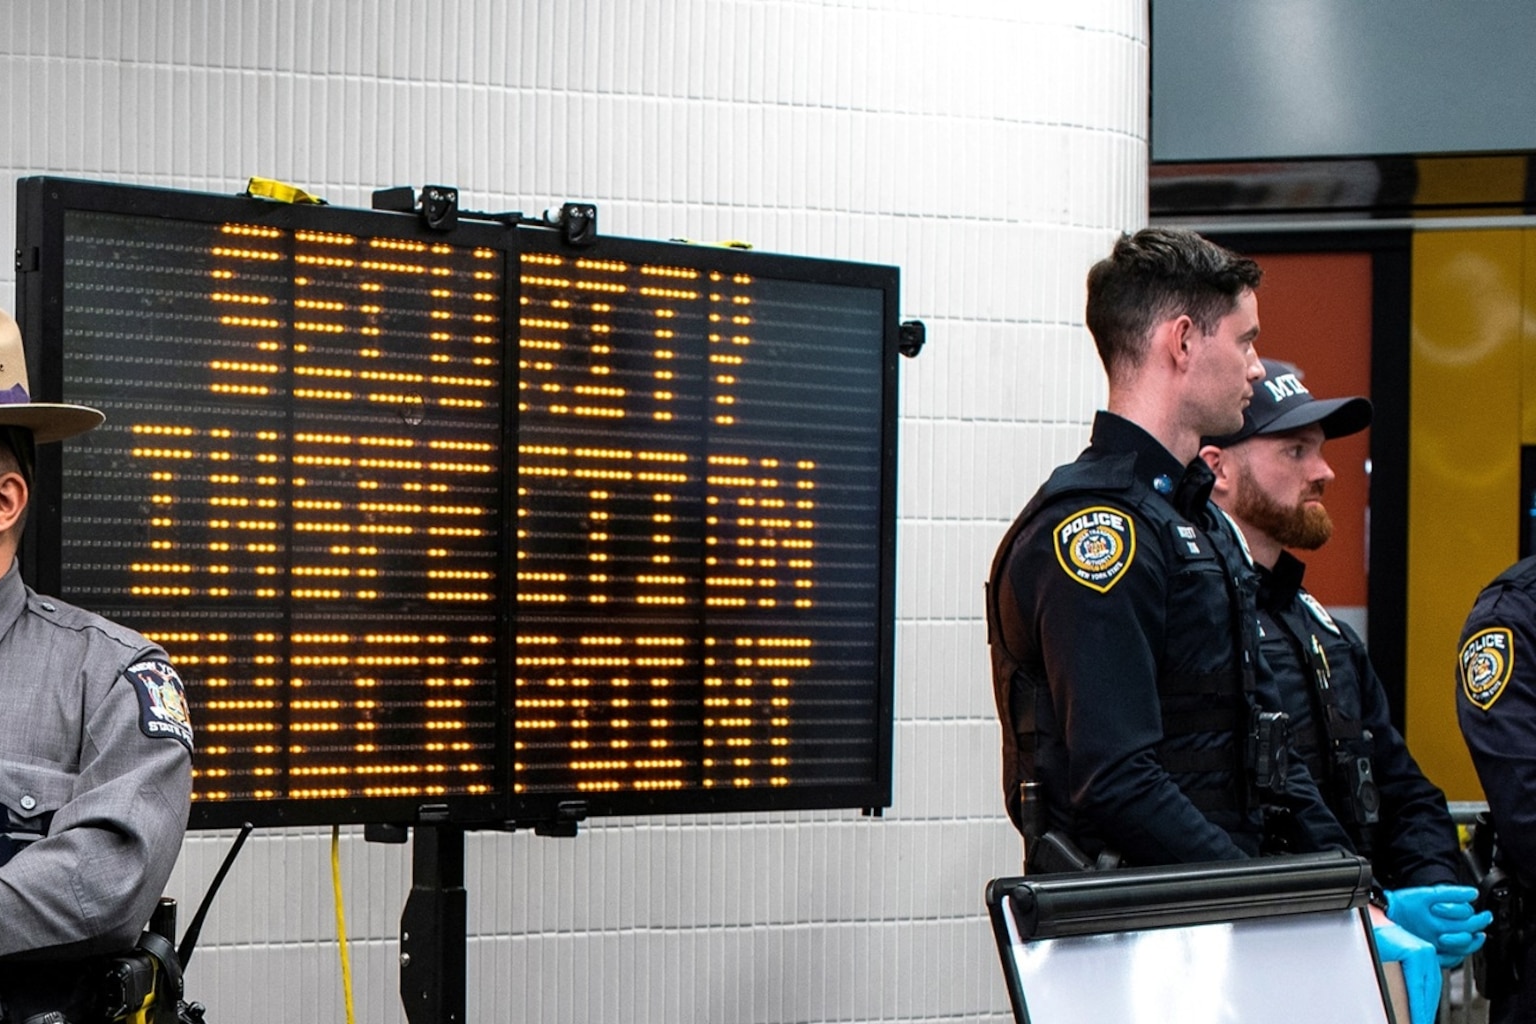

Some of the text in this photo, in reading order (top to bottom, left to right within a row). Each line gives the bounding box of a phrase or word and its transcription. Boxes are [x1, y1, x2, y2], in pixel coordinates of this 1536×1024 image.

[210, 223, 754, 427] SECURITY
[128, 423, 818, 610] INSPECTION
[1061, 512, 1125, 544] POLICE
[144, 630, 812, 800] HECKPOINT
[1463, 633, 1506, 669] POLICE
